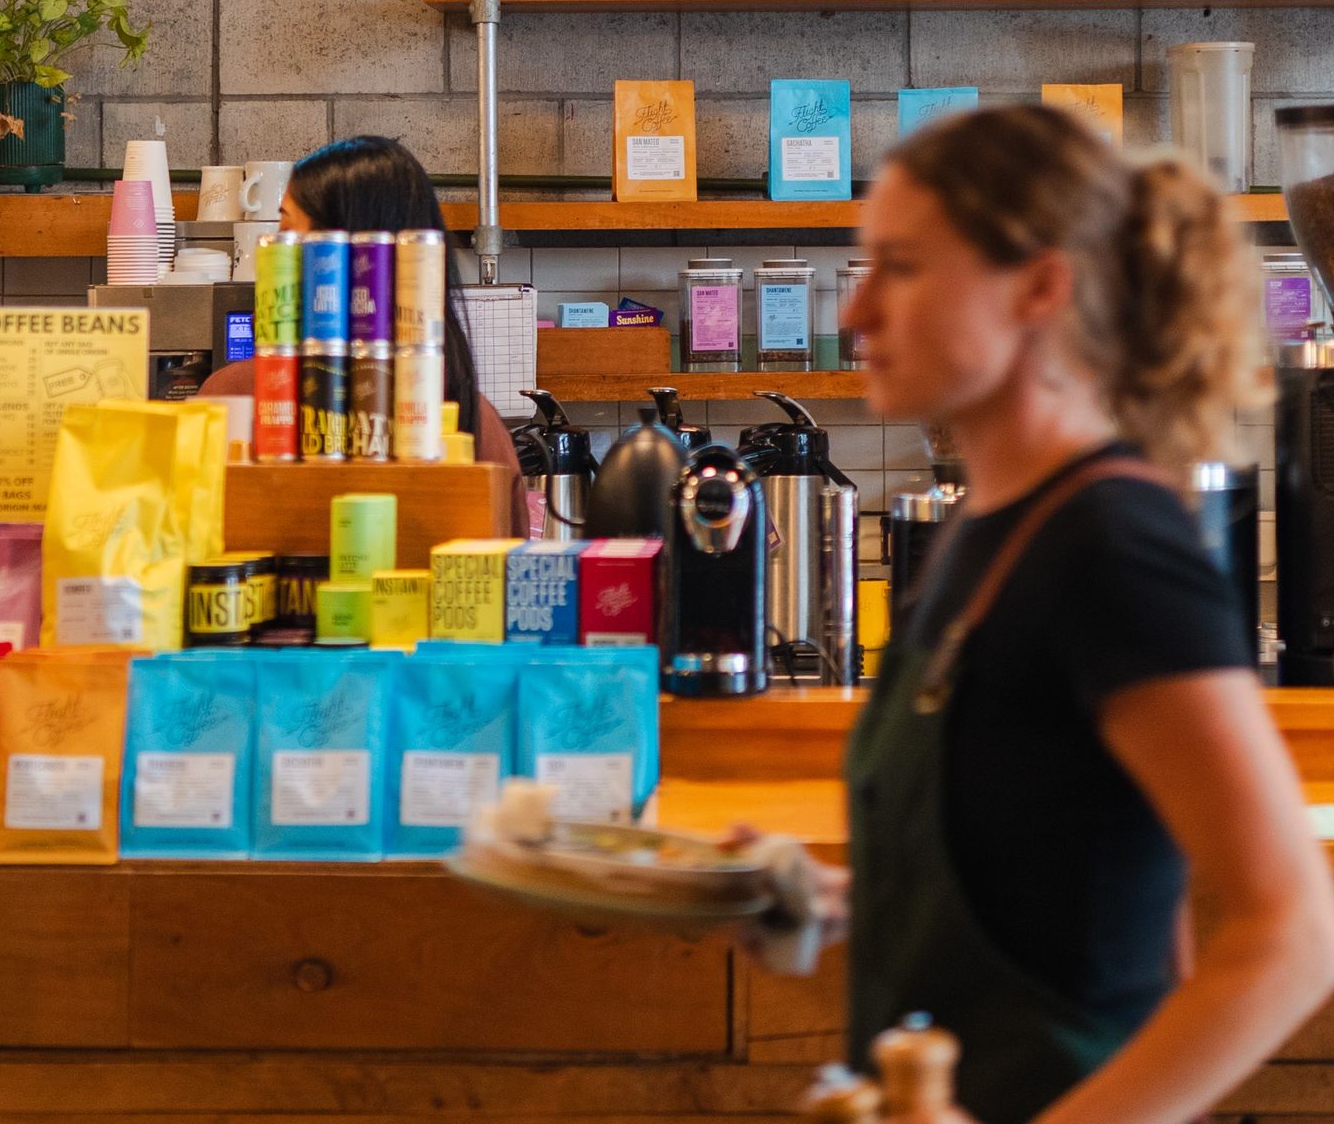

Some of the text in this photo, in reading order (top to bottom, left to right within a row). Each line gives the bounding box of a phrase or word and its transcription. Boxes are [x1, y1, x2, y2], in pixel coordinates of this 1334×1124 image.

[60, 315, 140, 335] BEANS
[616, 315, 654, 326] Sunshine
[434, 555, 503, 579] SPECIAL
[507, 555, 576, 581] SPECIAL
[434, 580, 491, 605] COFFEE
[508, 581, 567, 606] COFFEE
[434, 605, 477, 630] PODS
[508, 606, 554, 631] PODS
